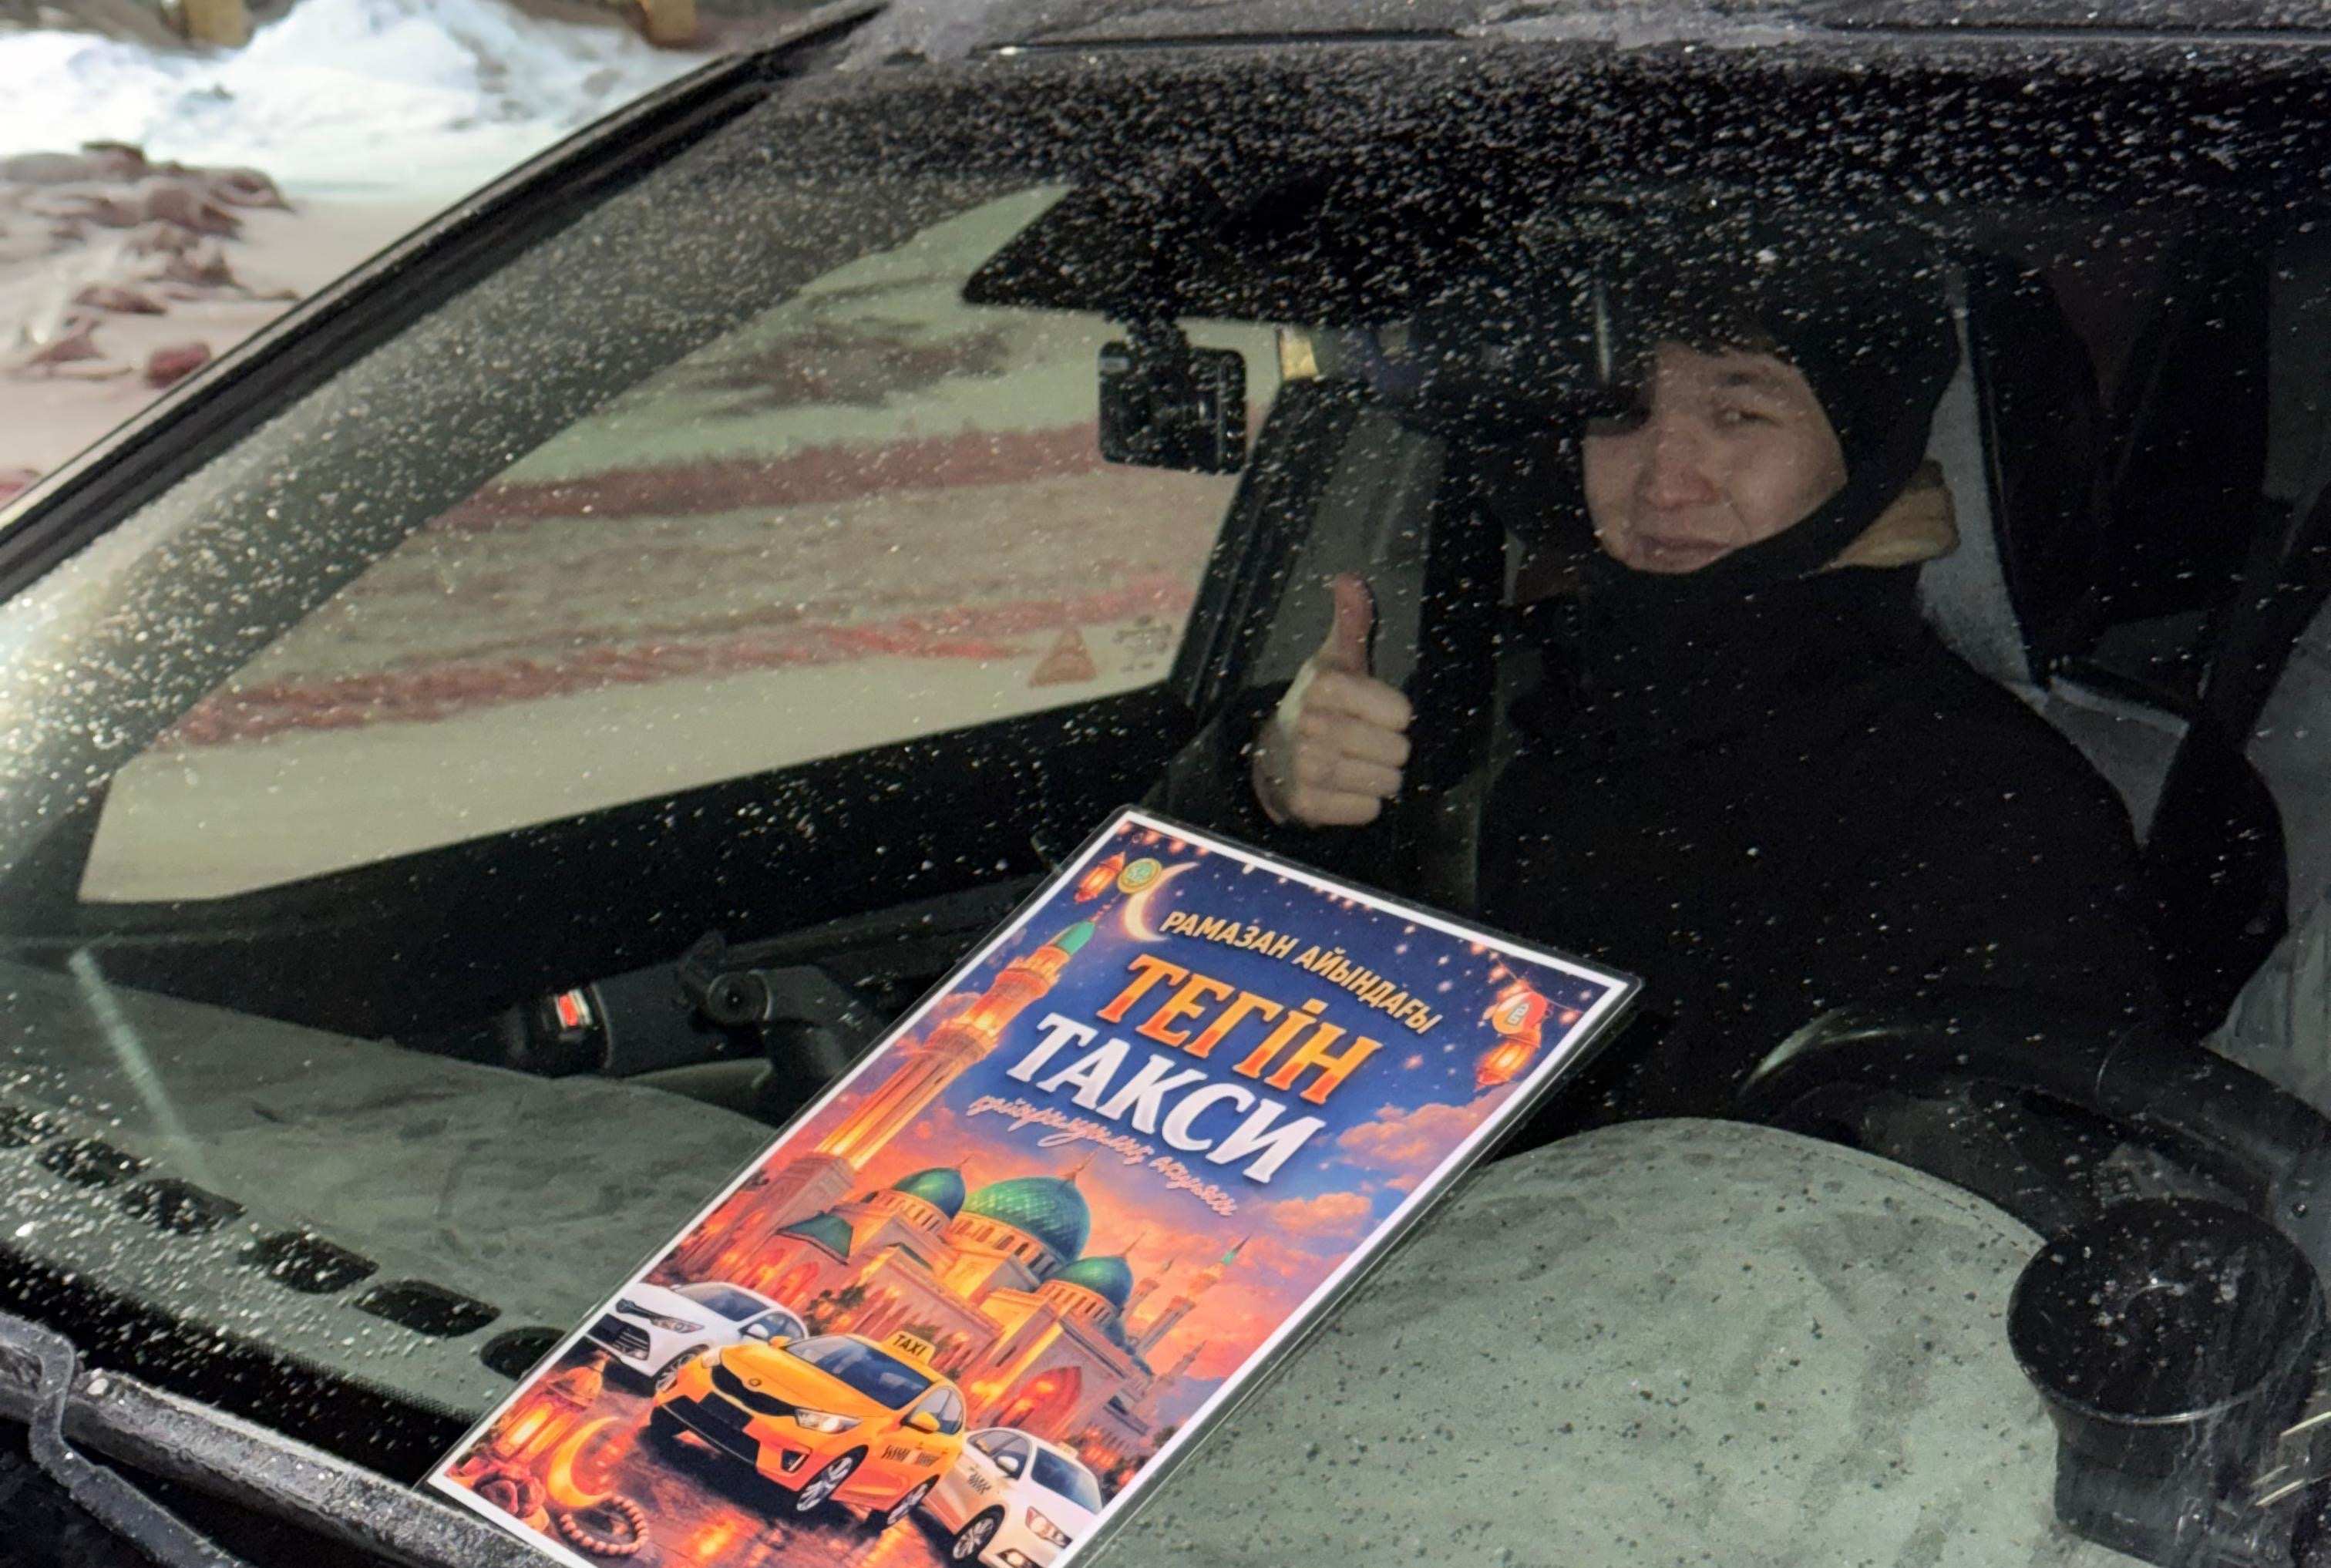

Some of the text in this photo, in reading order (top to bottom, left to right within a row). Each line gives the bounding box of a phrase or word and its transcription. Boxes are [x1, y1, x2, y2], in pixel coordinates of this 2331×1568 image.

[1096, 953, 1384, 1105] ТЕГІН
[1159, 910, 1443, 1035] РАМАЗАН АЙЫНДАҒЫ
[1006, 1011, 1327, 1184] ТАКСИ
[892, 1334, 929, 1357] TAXI
